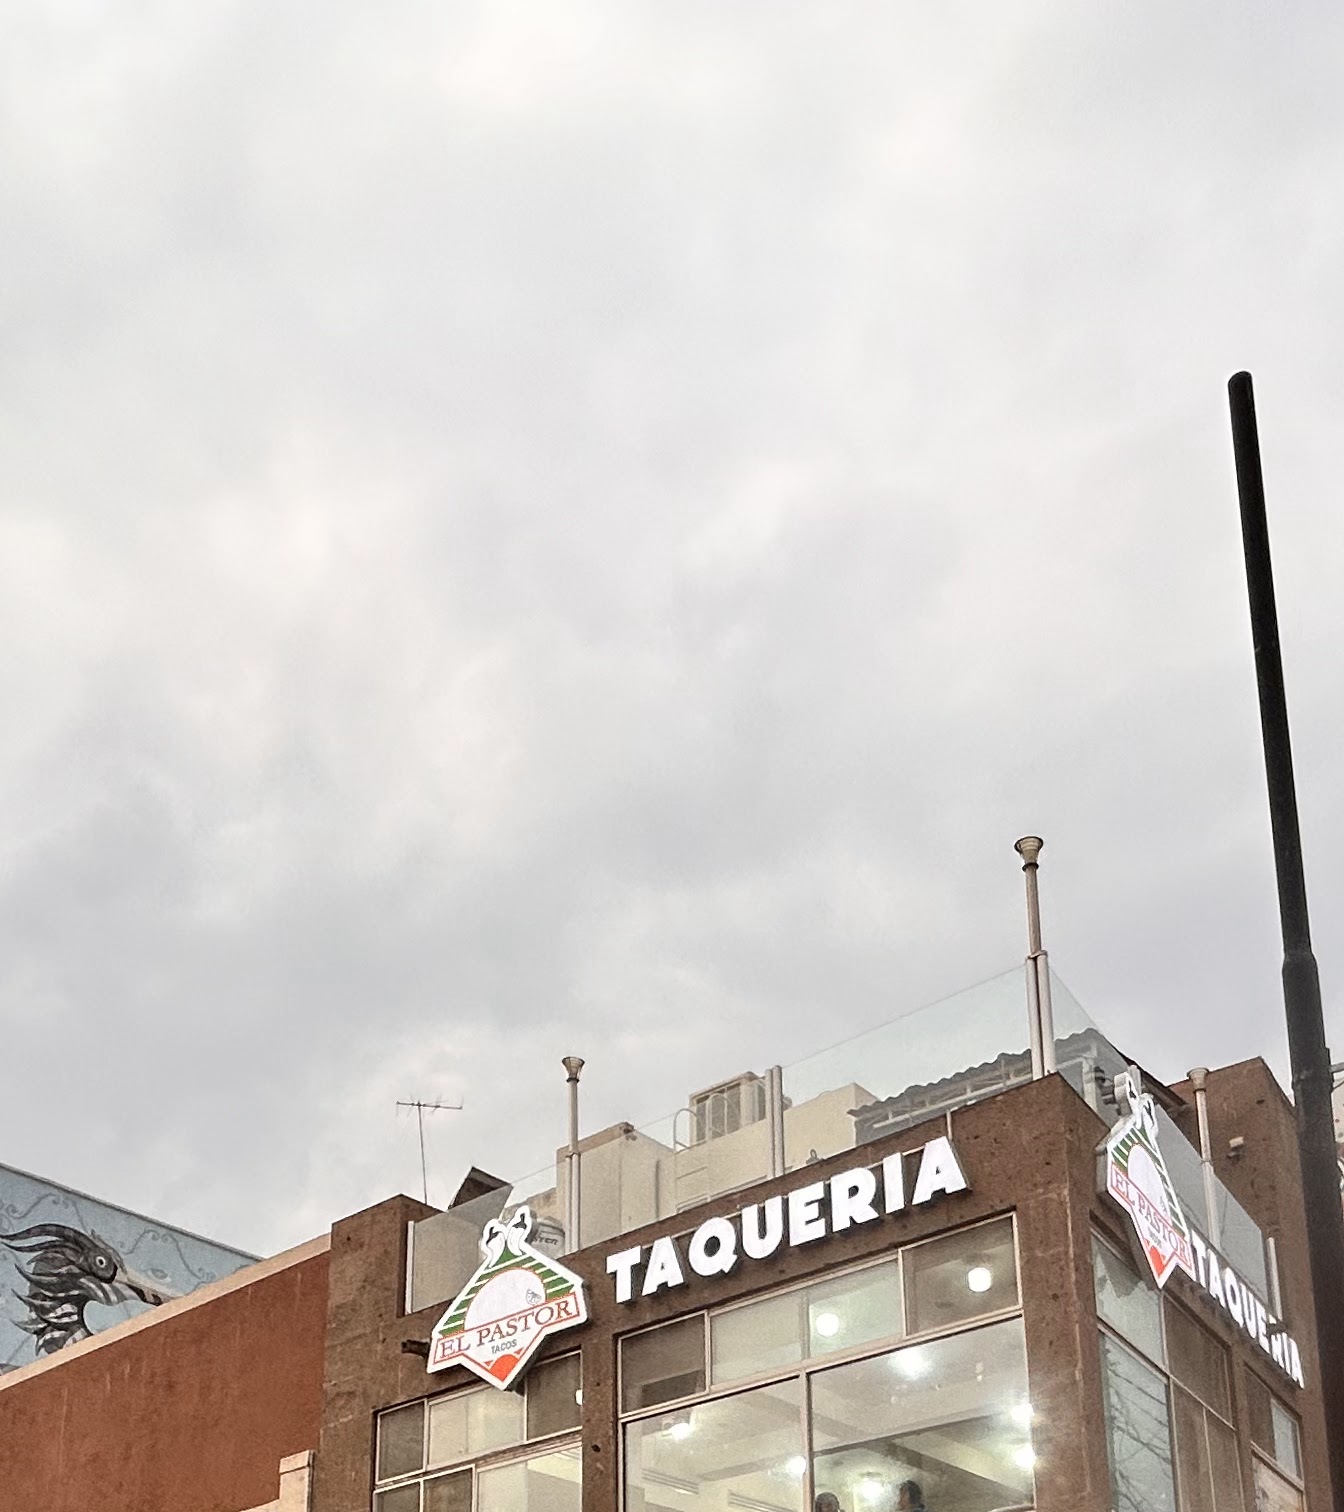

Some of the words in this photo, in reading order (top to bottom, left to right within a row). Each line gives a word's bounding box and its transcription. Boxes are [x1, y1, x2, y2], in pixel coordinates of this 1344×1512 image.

[606, 1136, 968, 1304] TAQUERIA
[1113, 1168, 1136, 1207] EL
[1137, 1195, 1189, 1265] PASTOR
[439, 1335, 471, 1358] EL
[476, 1300, 573, 1347] PASTOR
[491, 1339, 518, 1354] TACOS
